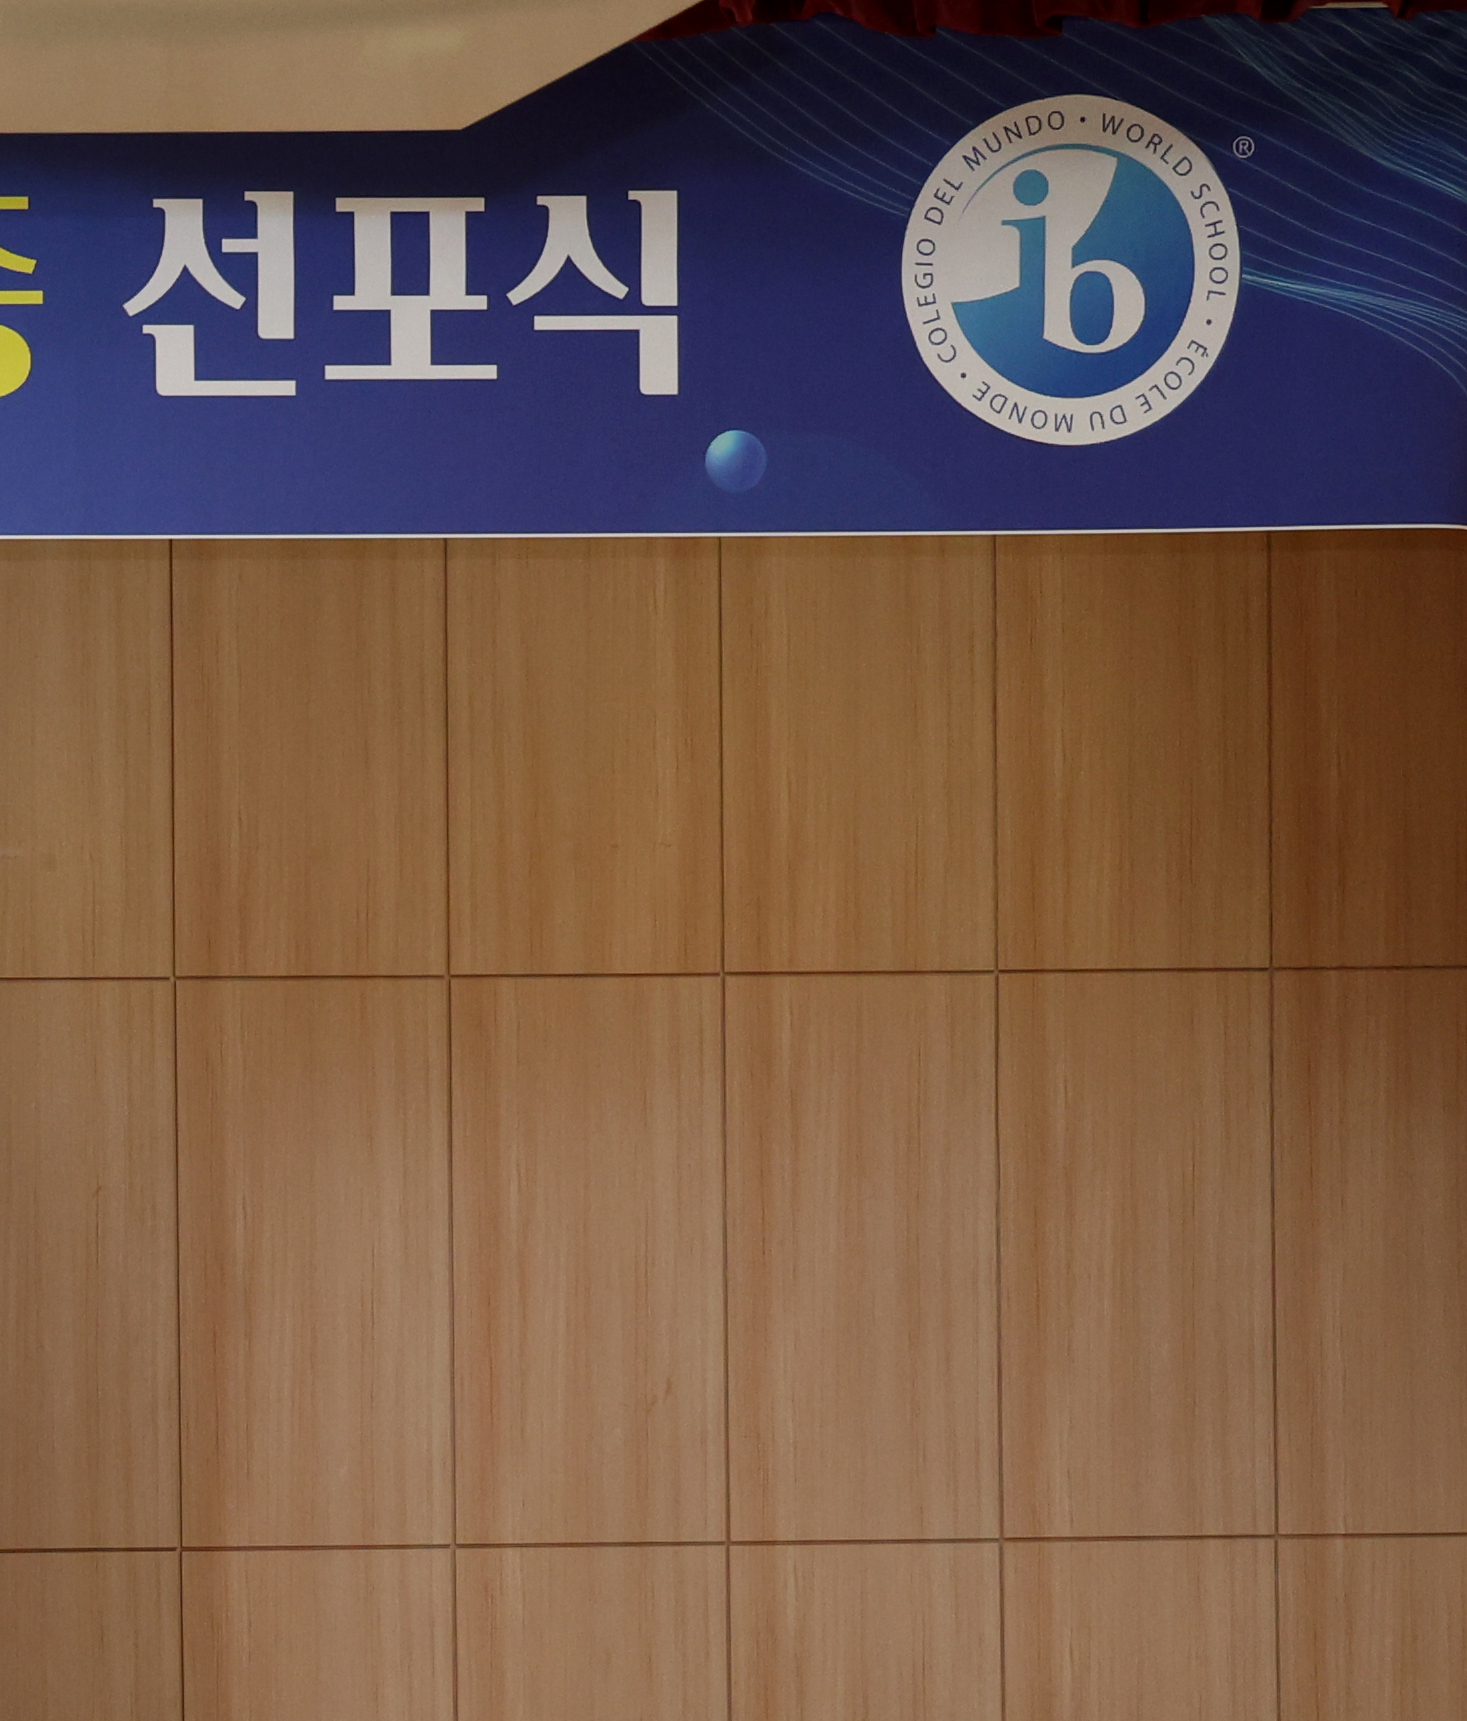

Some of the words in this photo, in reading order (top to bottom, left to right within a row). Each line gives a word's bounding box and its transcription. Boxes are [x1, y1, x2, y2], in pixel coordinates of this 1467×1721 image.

[962, 110, 1066, 172] MUNDO
[924, 177, 963, 225] DEL
[1101, 112, 1193, 178] WORLD
[1190, 182, 1229, 301] SCHOOL
[123, 191, 678, 396] 선포식
[915, 238, 956, 363] COLEGIO
[971, 380, 1074, 433] MONDE
[1089, 404, 1128, 431] DU
